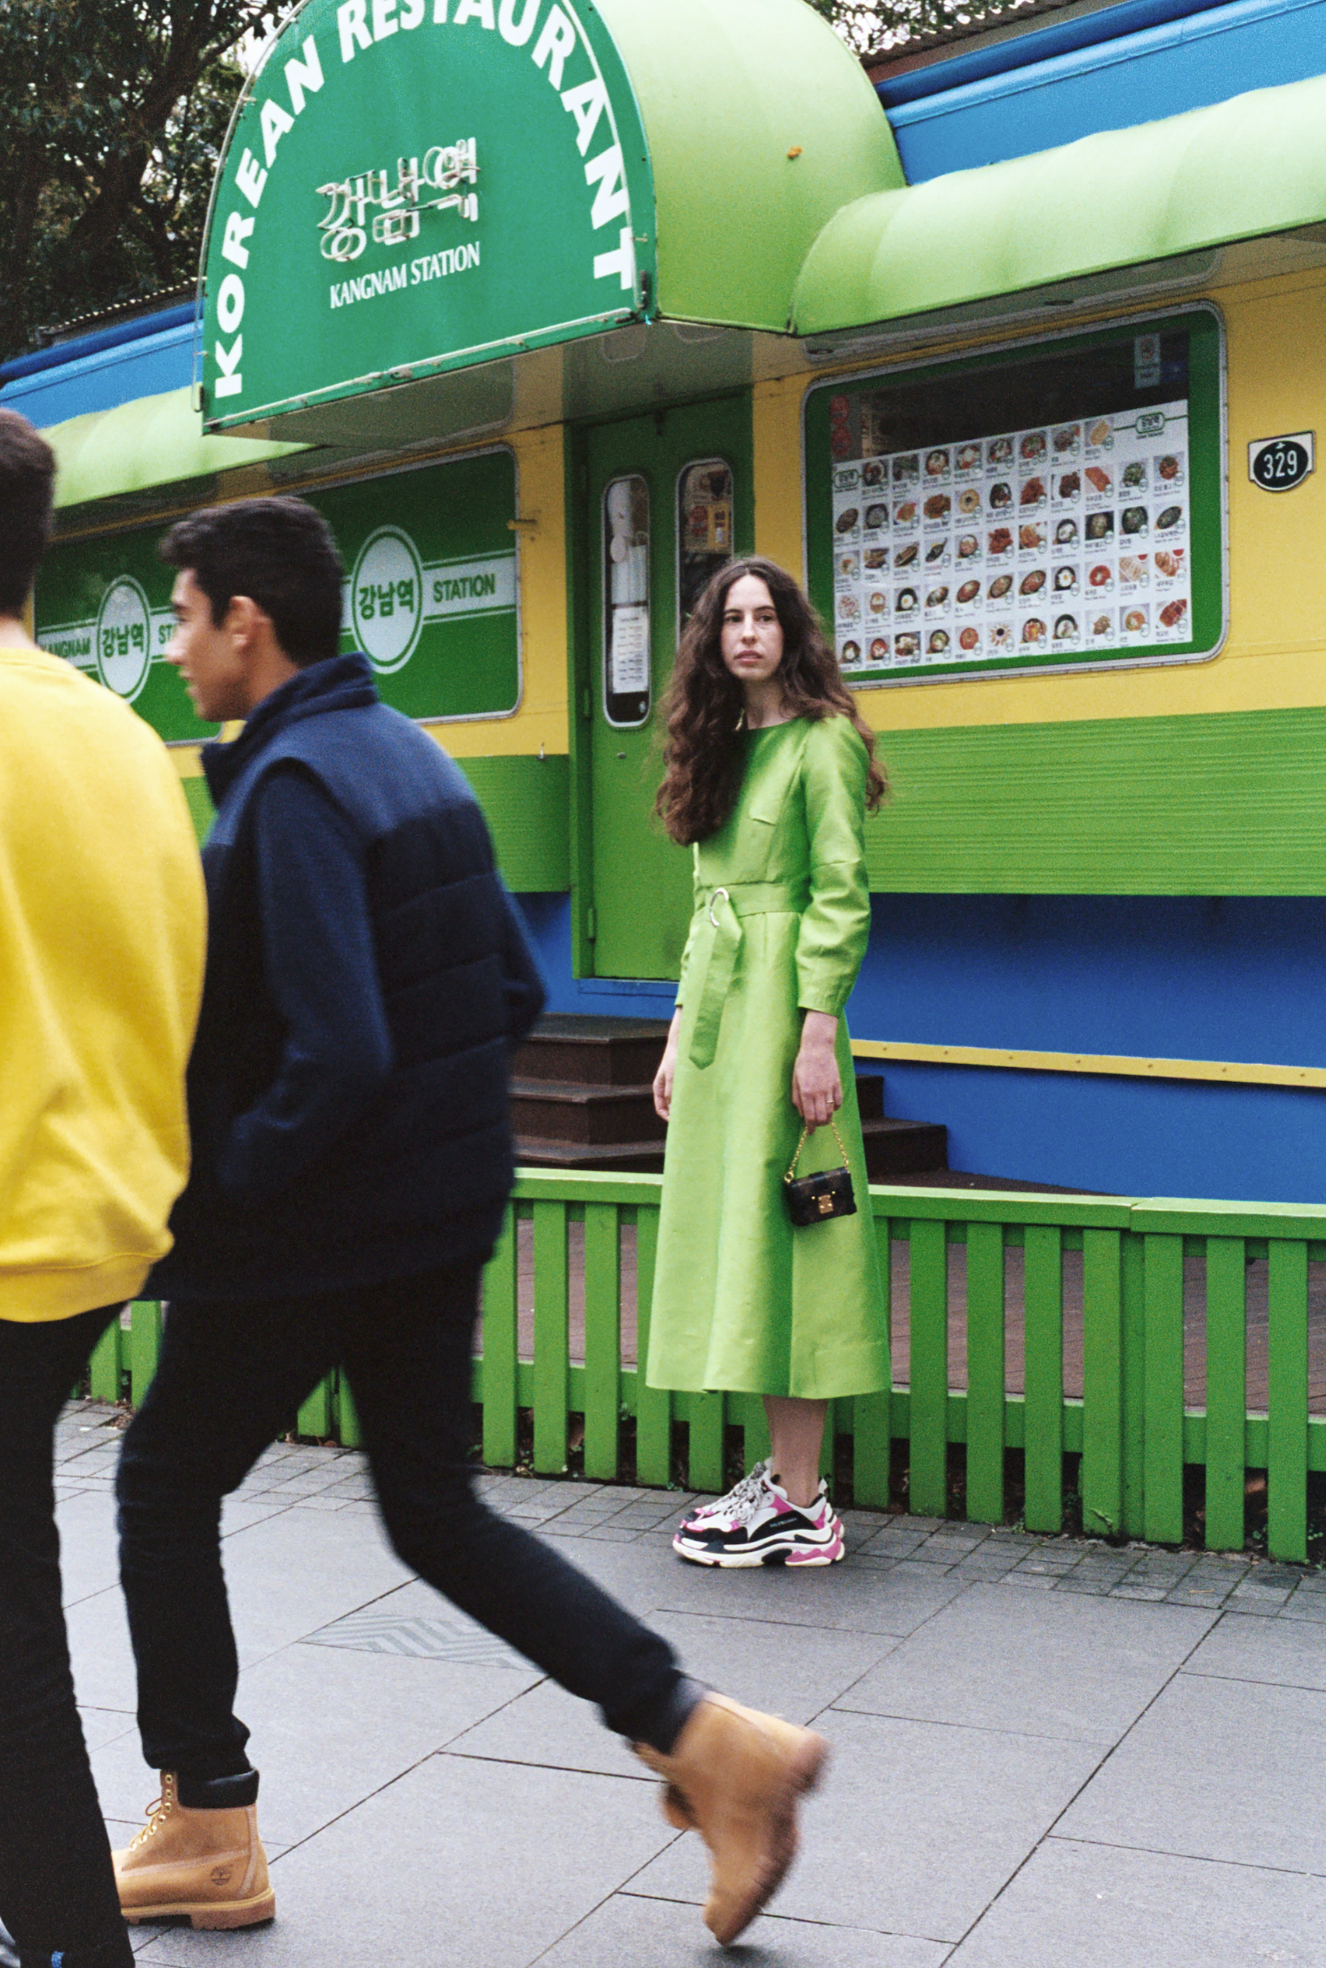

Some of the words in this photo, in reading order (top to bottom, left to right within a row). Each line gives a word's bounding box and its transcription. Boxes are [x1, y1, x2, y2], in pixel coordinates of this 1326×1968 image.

[215, 35, 325, 398] KOREAN
[330, 264, 407, 309] KANGNAM
[411, 241, 480, 285] STATION
[1263, 449, 1298, 479] 329
[359, 578, 414, 620] 강남역
[433, 573, 496, 603] STATION
[102, 623, 145, 658] 강남역
